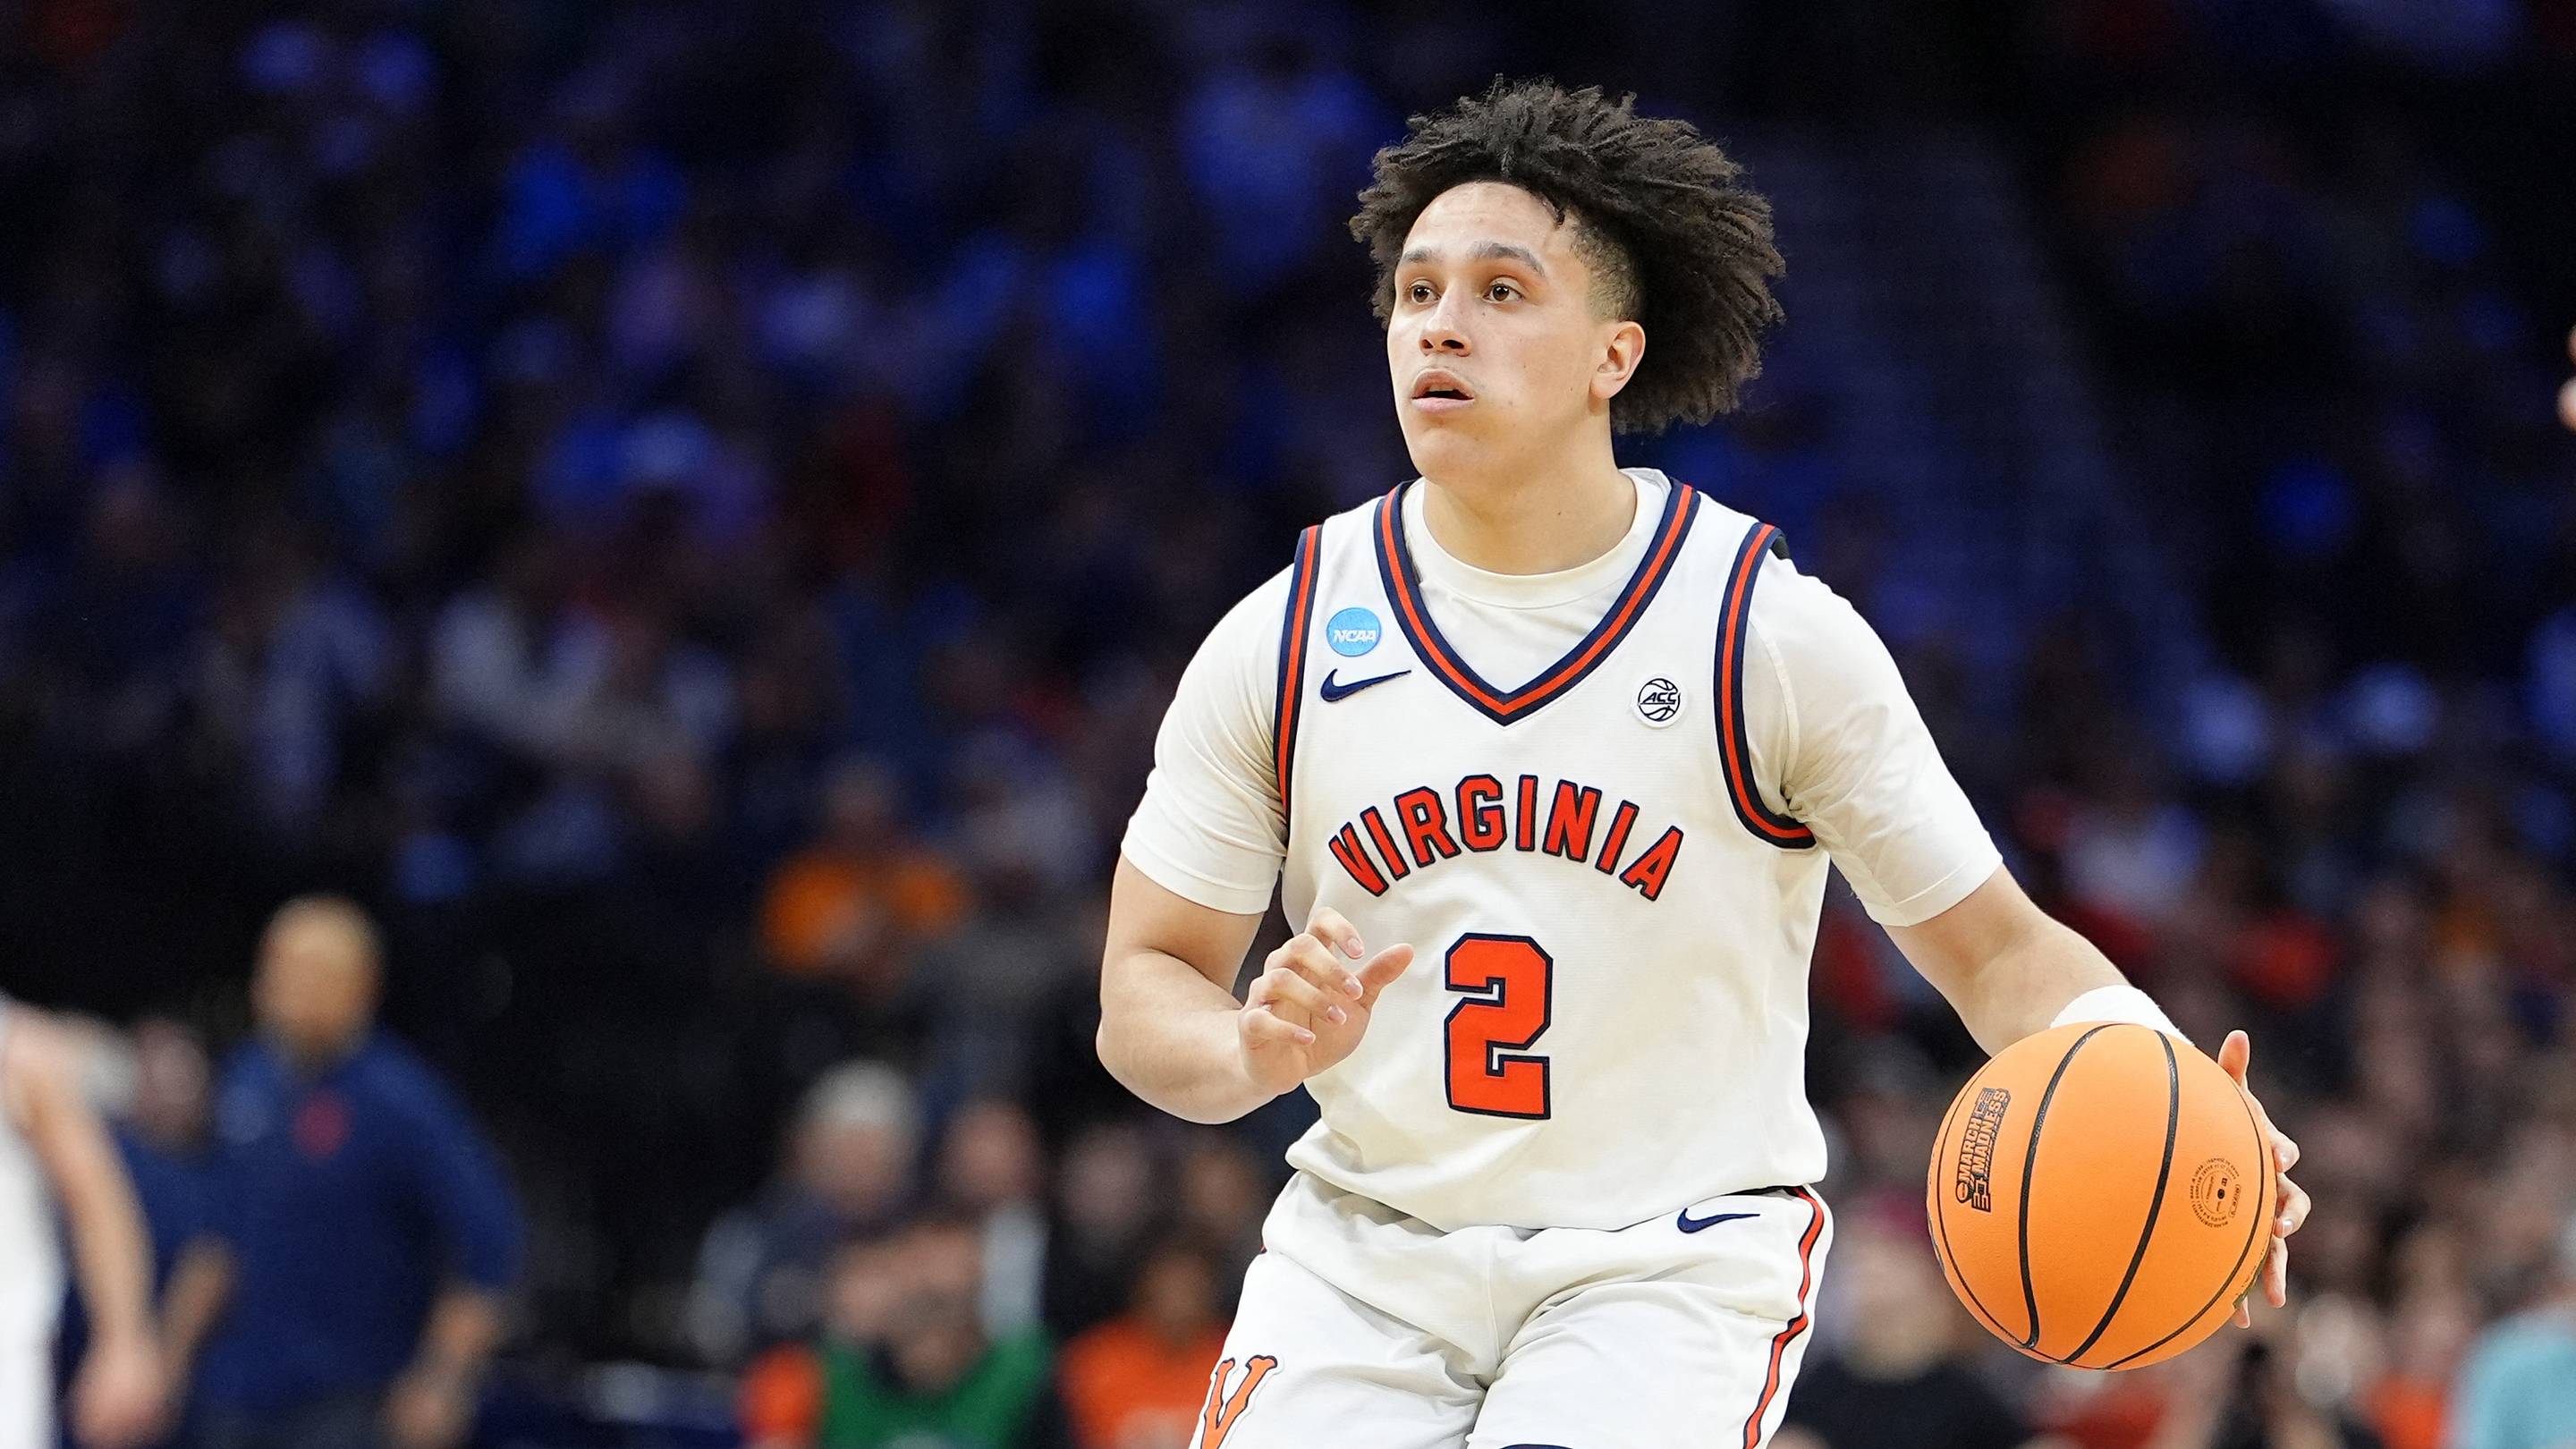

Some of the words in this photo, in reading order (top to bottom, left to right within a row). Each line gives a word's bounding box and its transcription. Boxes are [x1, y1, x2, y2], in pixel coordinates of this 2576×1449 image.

[1333, 630, 1377, 644] NCAA
[1642, 691, 1678, 704] ACC
[1328, 774, 1684, 902] VIRGINIA
[1444, 932, 1554, 1120] 2
[1958, 1117, 1982, 1183] MARCH
[1971, 1090, 2007, 1174] MADNESS
